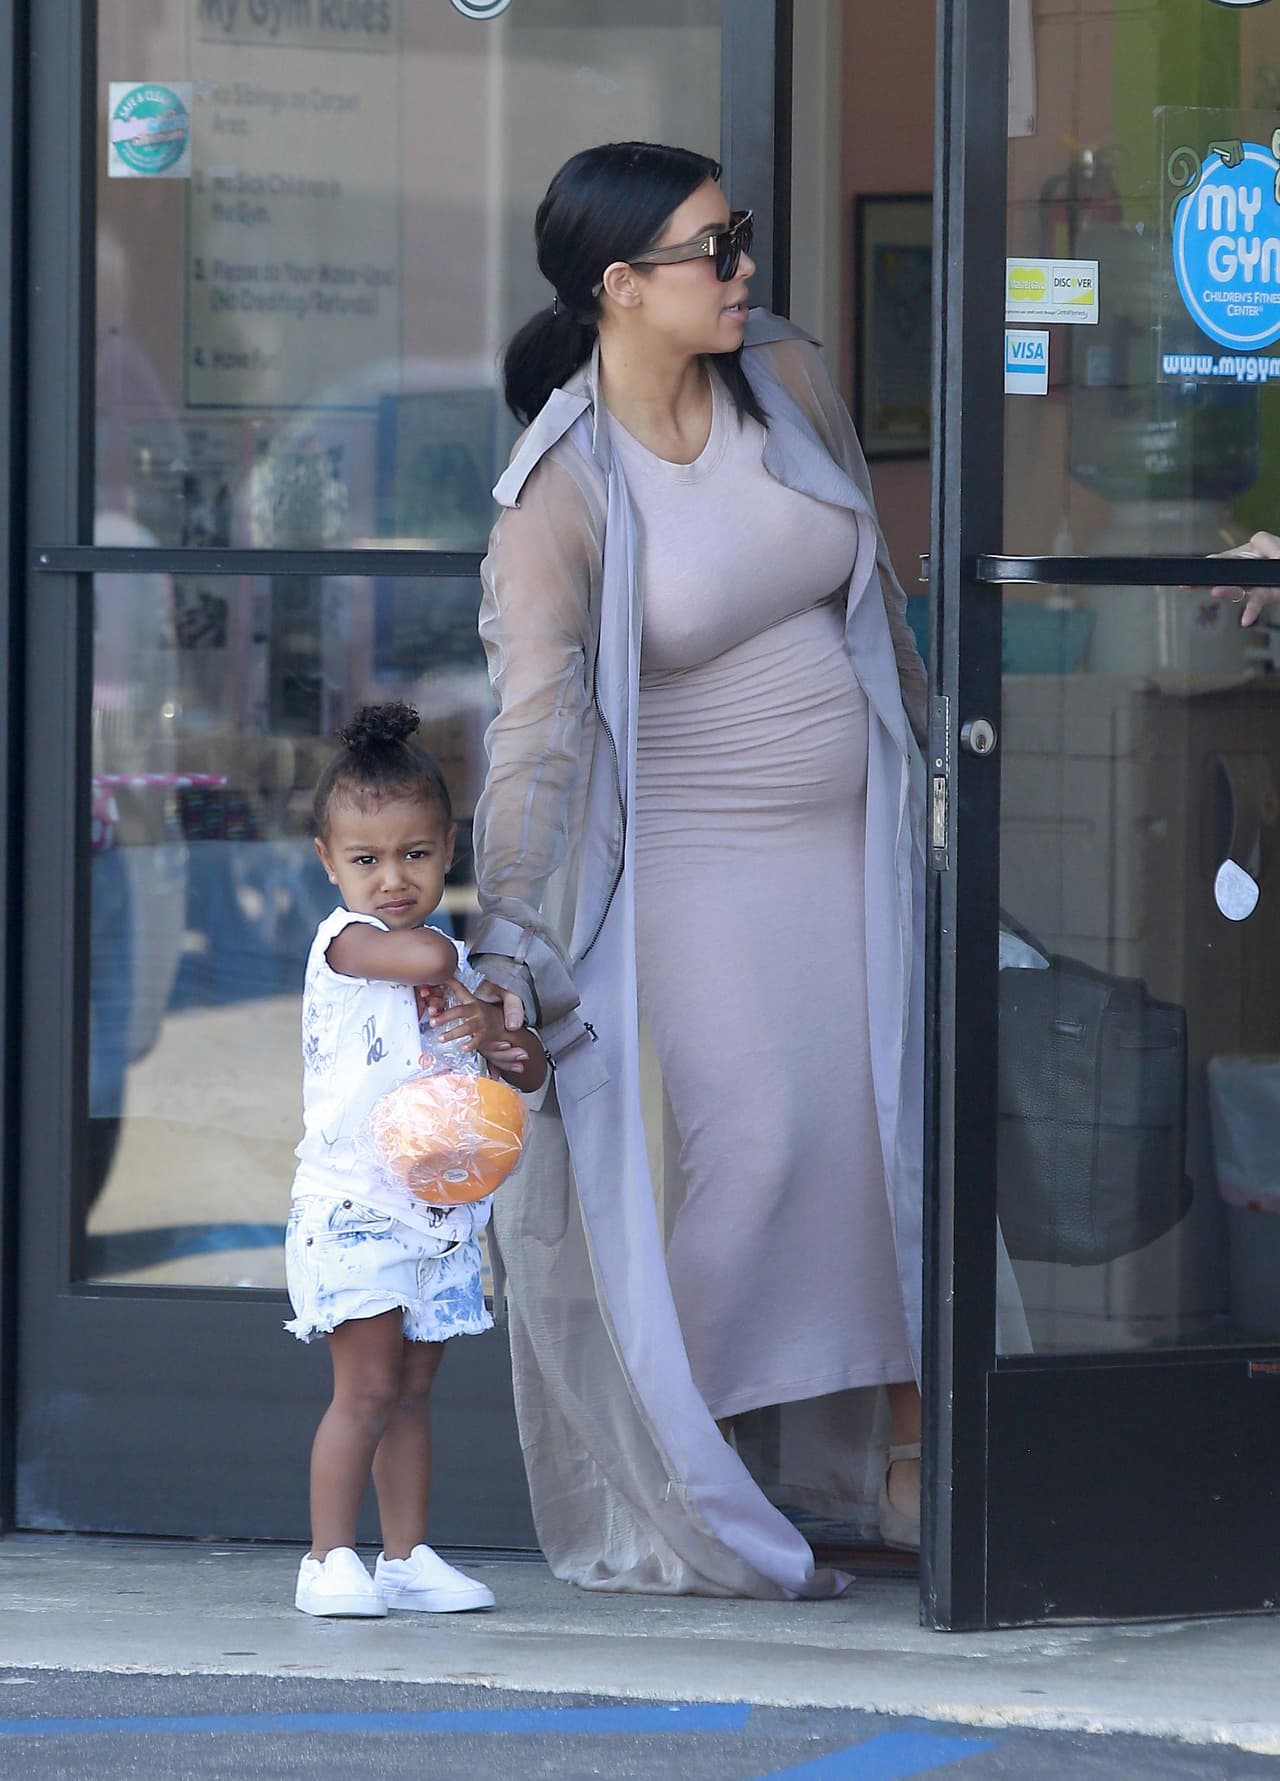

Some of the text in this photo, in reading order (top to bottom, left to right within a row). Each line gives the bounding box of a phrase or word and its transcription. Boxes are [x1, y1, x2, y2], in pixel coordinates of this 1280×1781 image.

[1198, 184, 1261, 232] MY
[1054, 278, 1092, 289] DISCOVER
[1011, 341, 1044, 360] VISA
